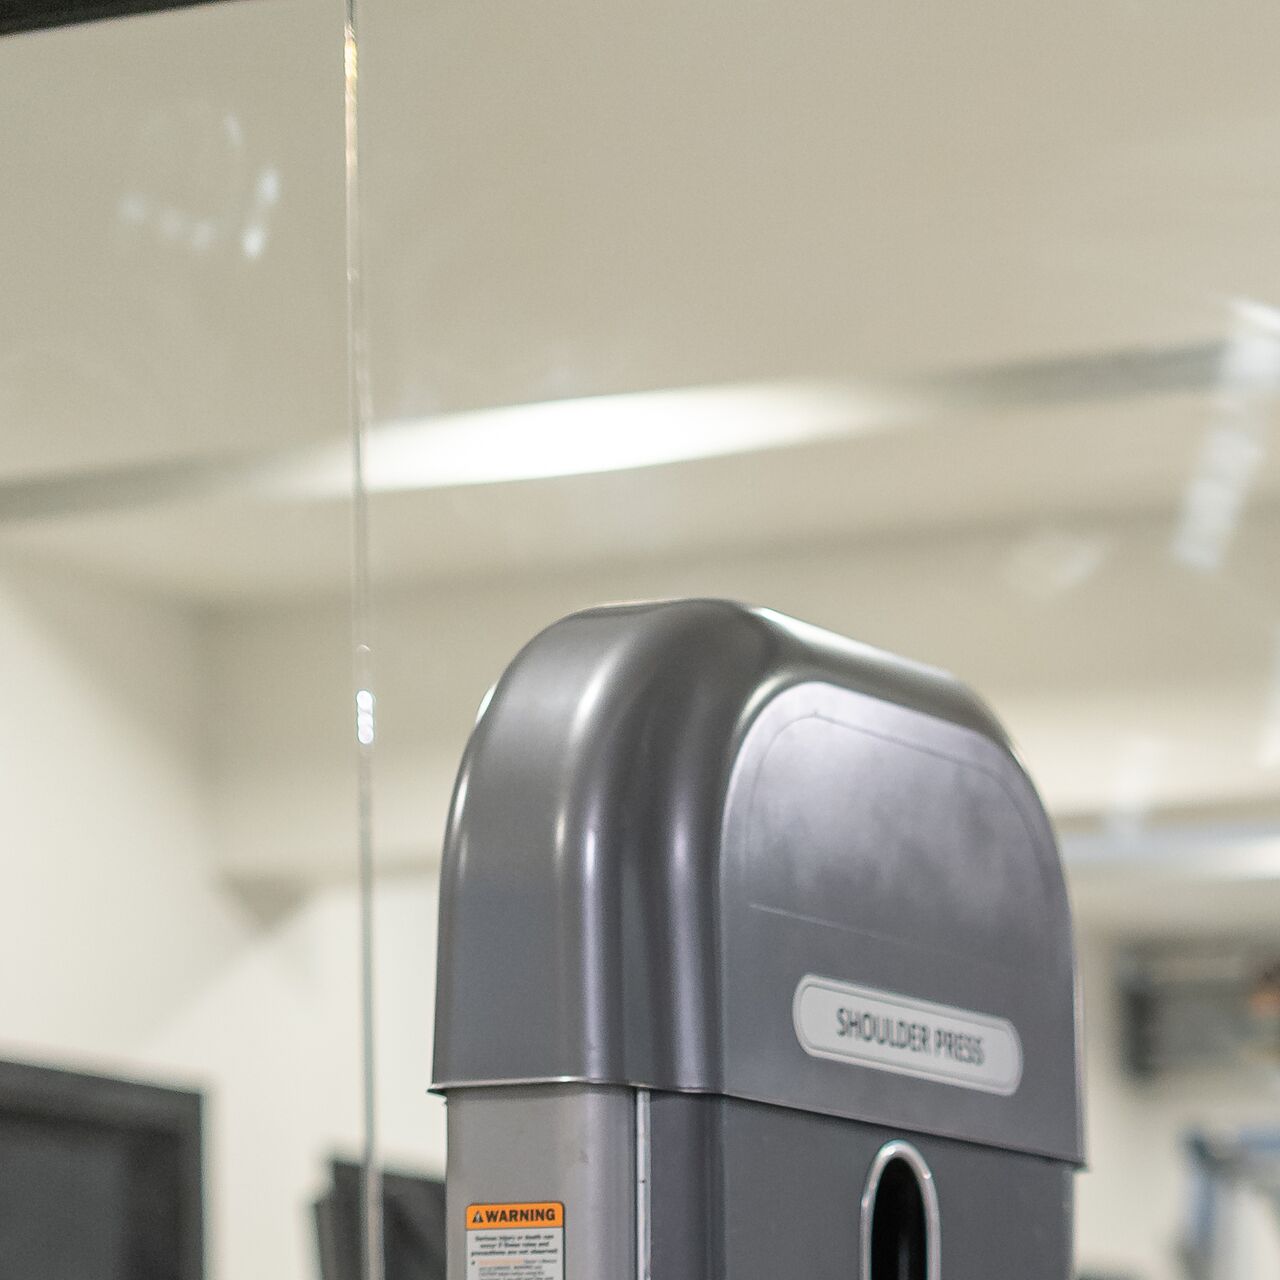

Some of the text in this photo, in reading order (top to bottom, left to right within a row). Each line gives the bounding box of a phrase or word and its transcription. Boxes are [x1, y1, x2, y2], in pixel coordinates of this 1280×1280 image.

[836, 1007, 985, 1067] SHOULDER PRESS
[485, 1208, 556, 1223] WARNING
